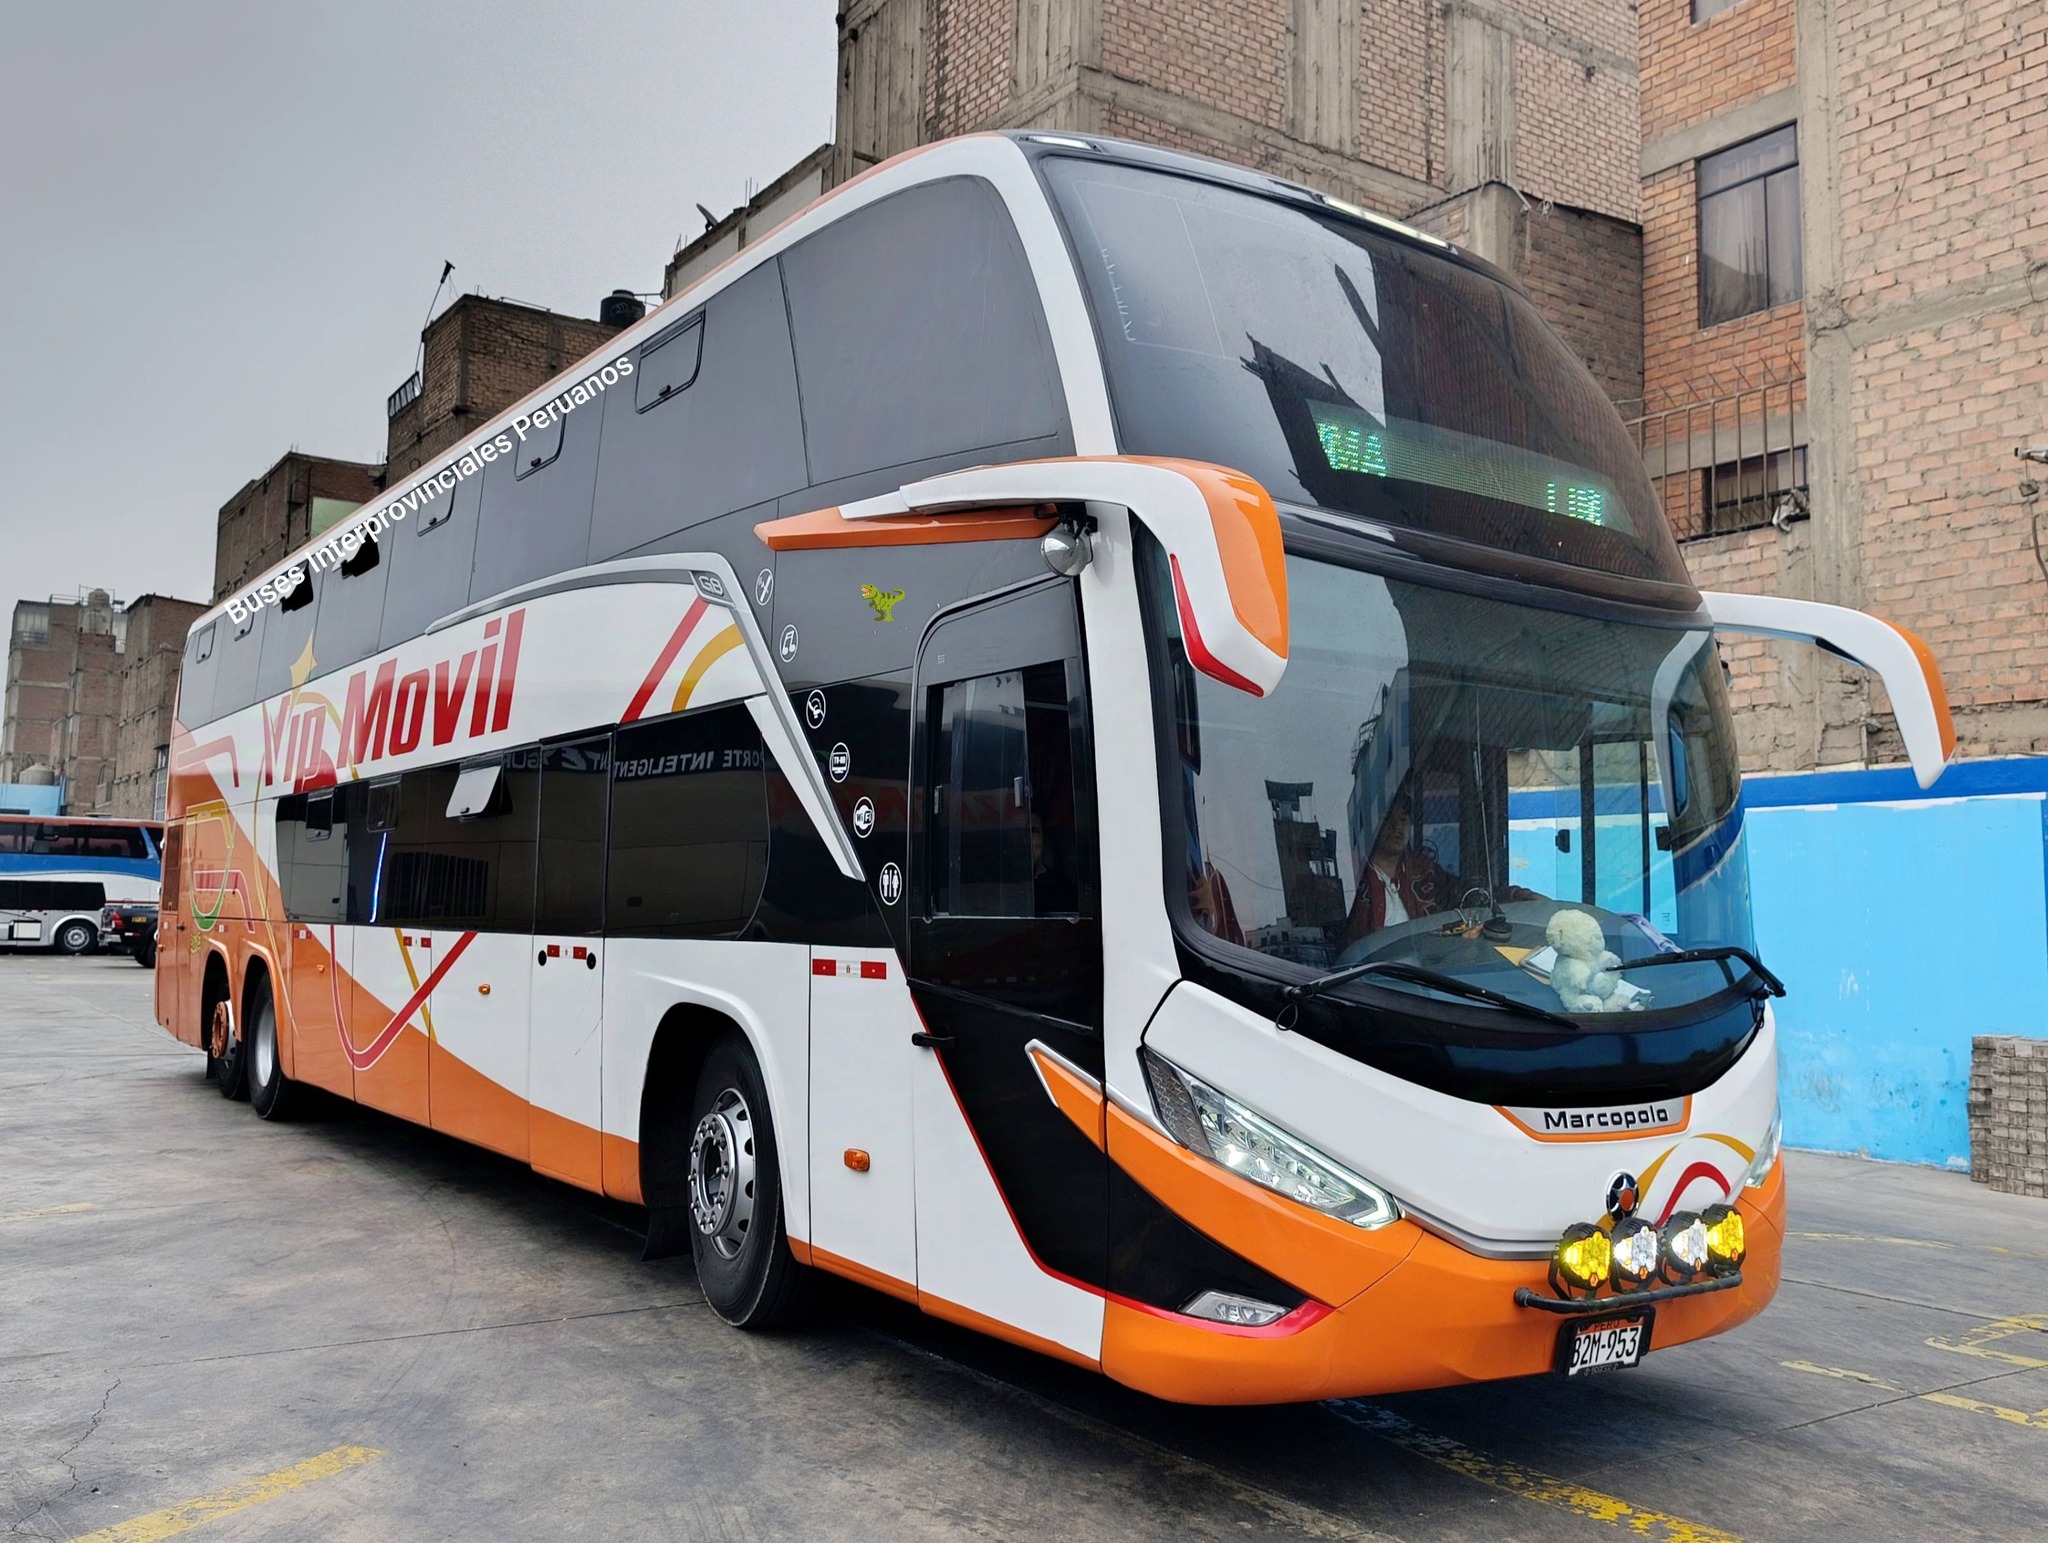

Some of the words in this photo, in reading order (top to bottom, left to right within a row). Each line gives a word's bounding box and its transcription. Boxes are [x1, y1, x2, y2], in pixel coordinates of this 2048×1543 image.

[336, 608, 526, 769] Movil
[1543, 1105, 1669, 1129] Marcopolo
[1570, 1326, 1639, 1368] B2M-953
